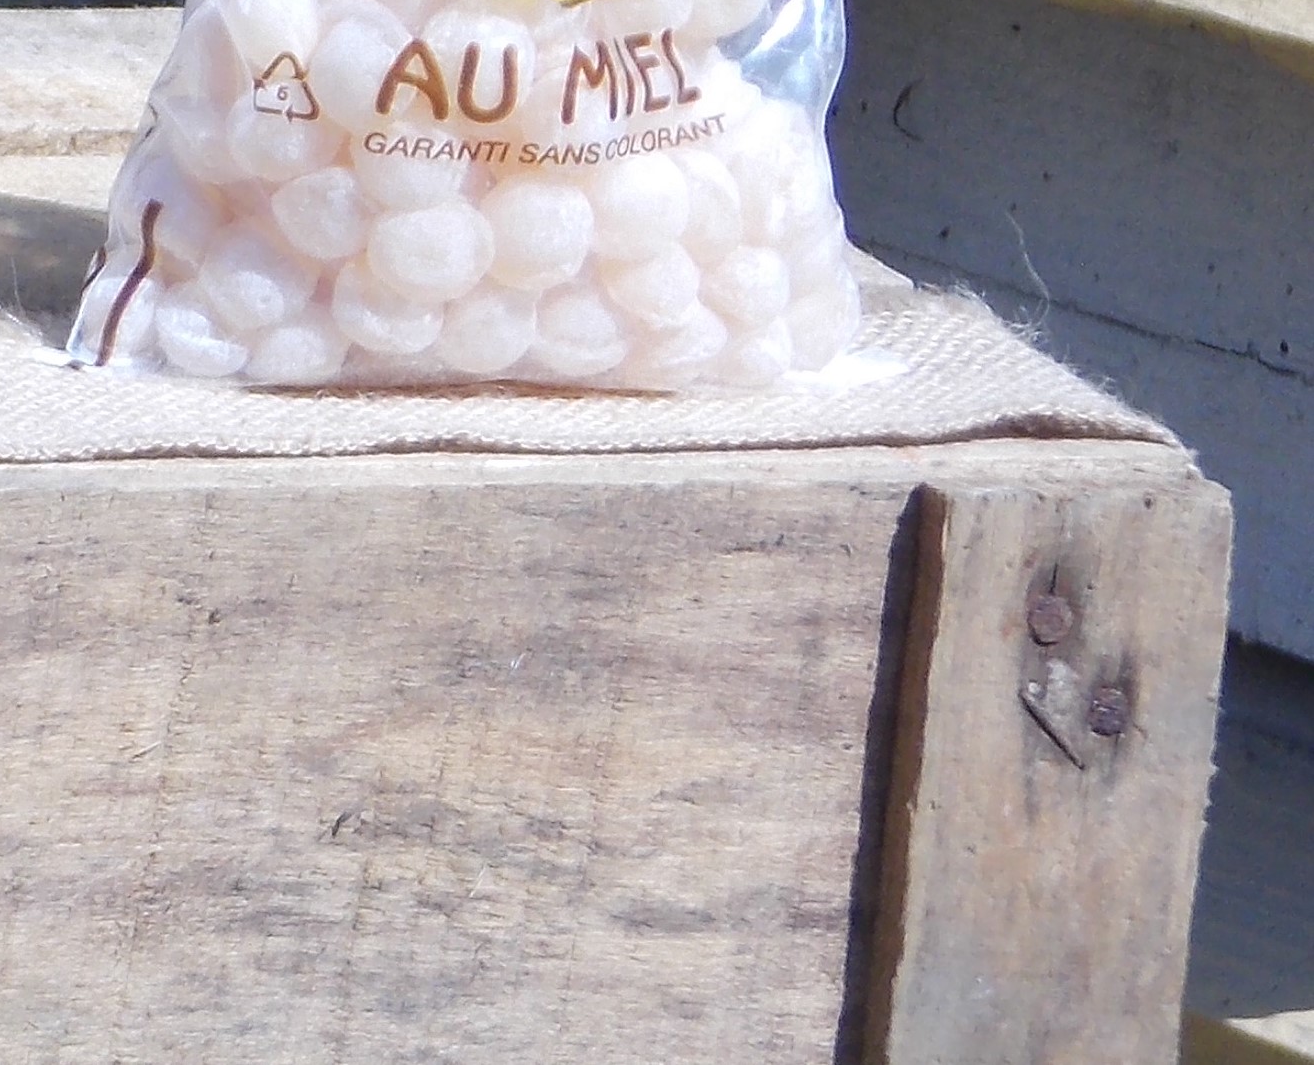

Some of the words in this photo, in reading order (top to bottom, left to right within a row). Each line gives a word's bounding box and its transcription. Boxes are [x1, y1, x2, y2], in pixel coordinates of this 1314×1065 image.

[374, 37, 520, 125] AU
[559, 27, 702, 126] MIEL
[362, 132, 509, 164] GARANTI
[518, 142, 602, 166] SANS
[604, 113, 727, 163] COLORANT
